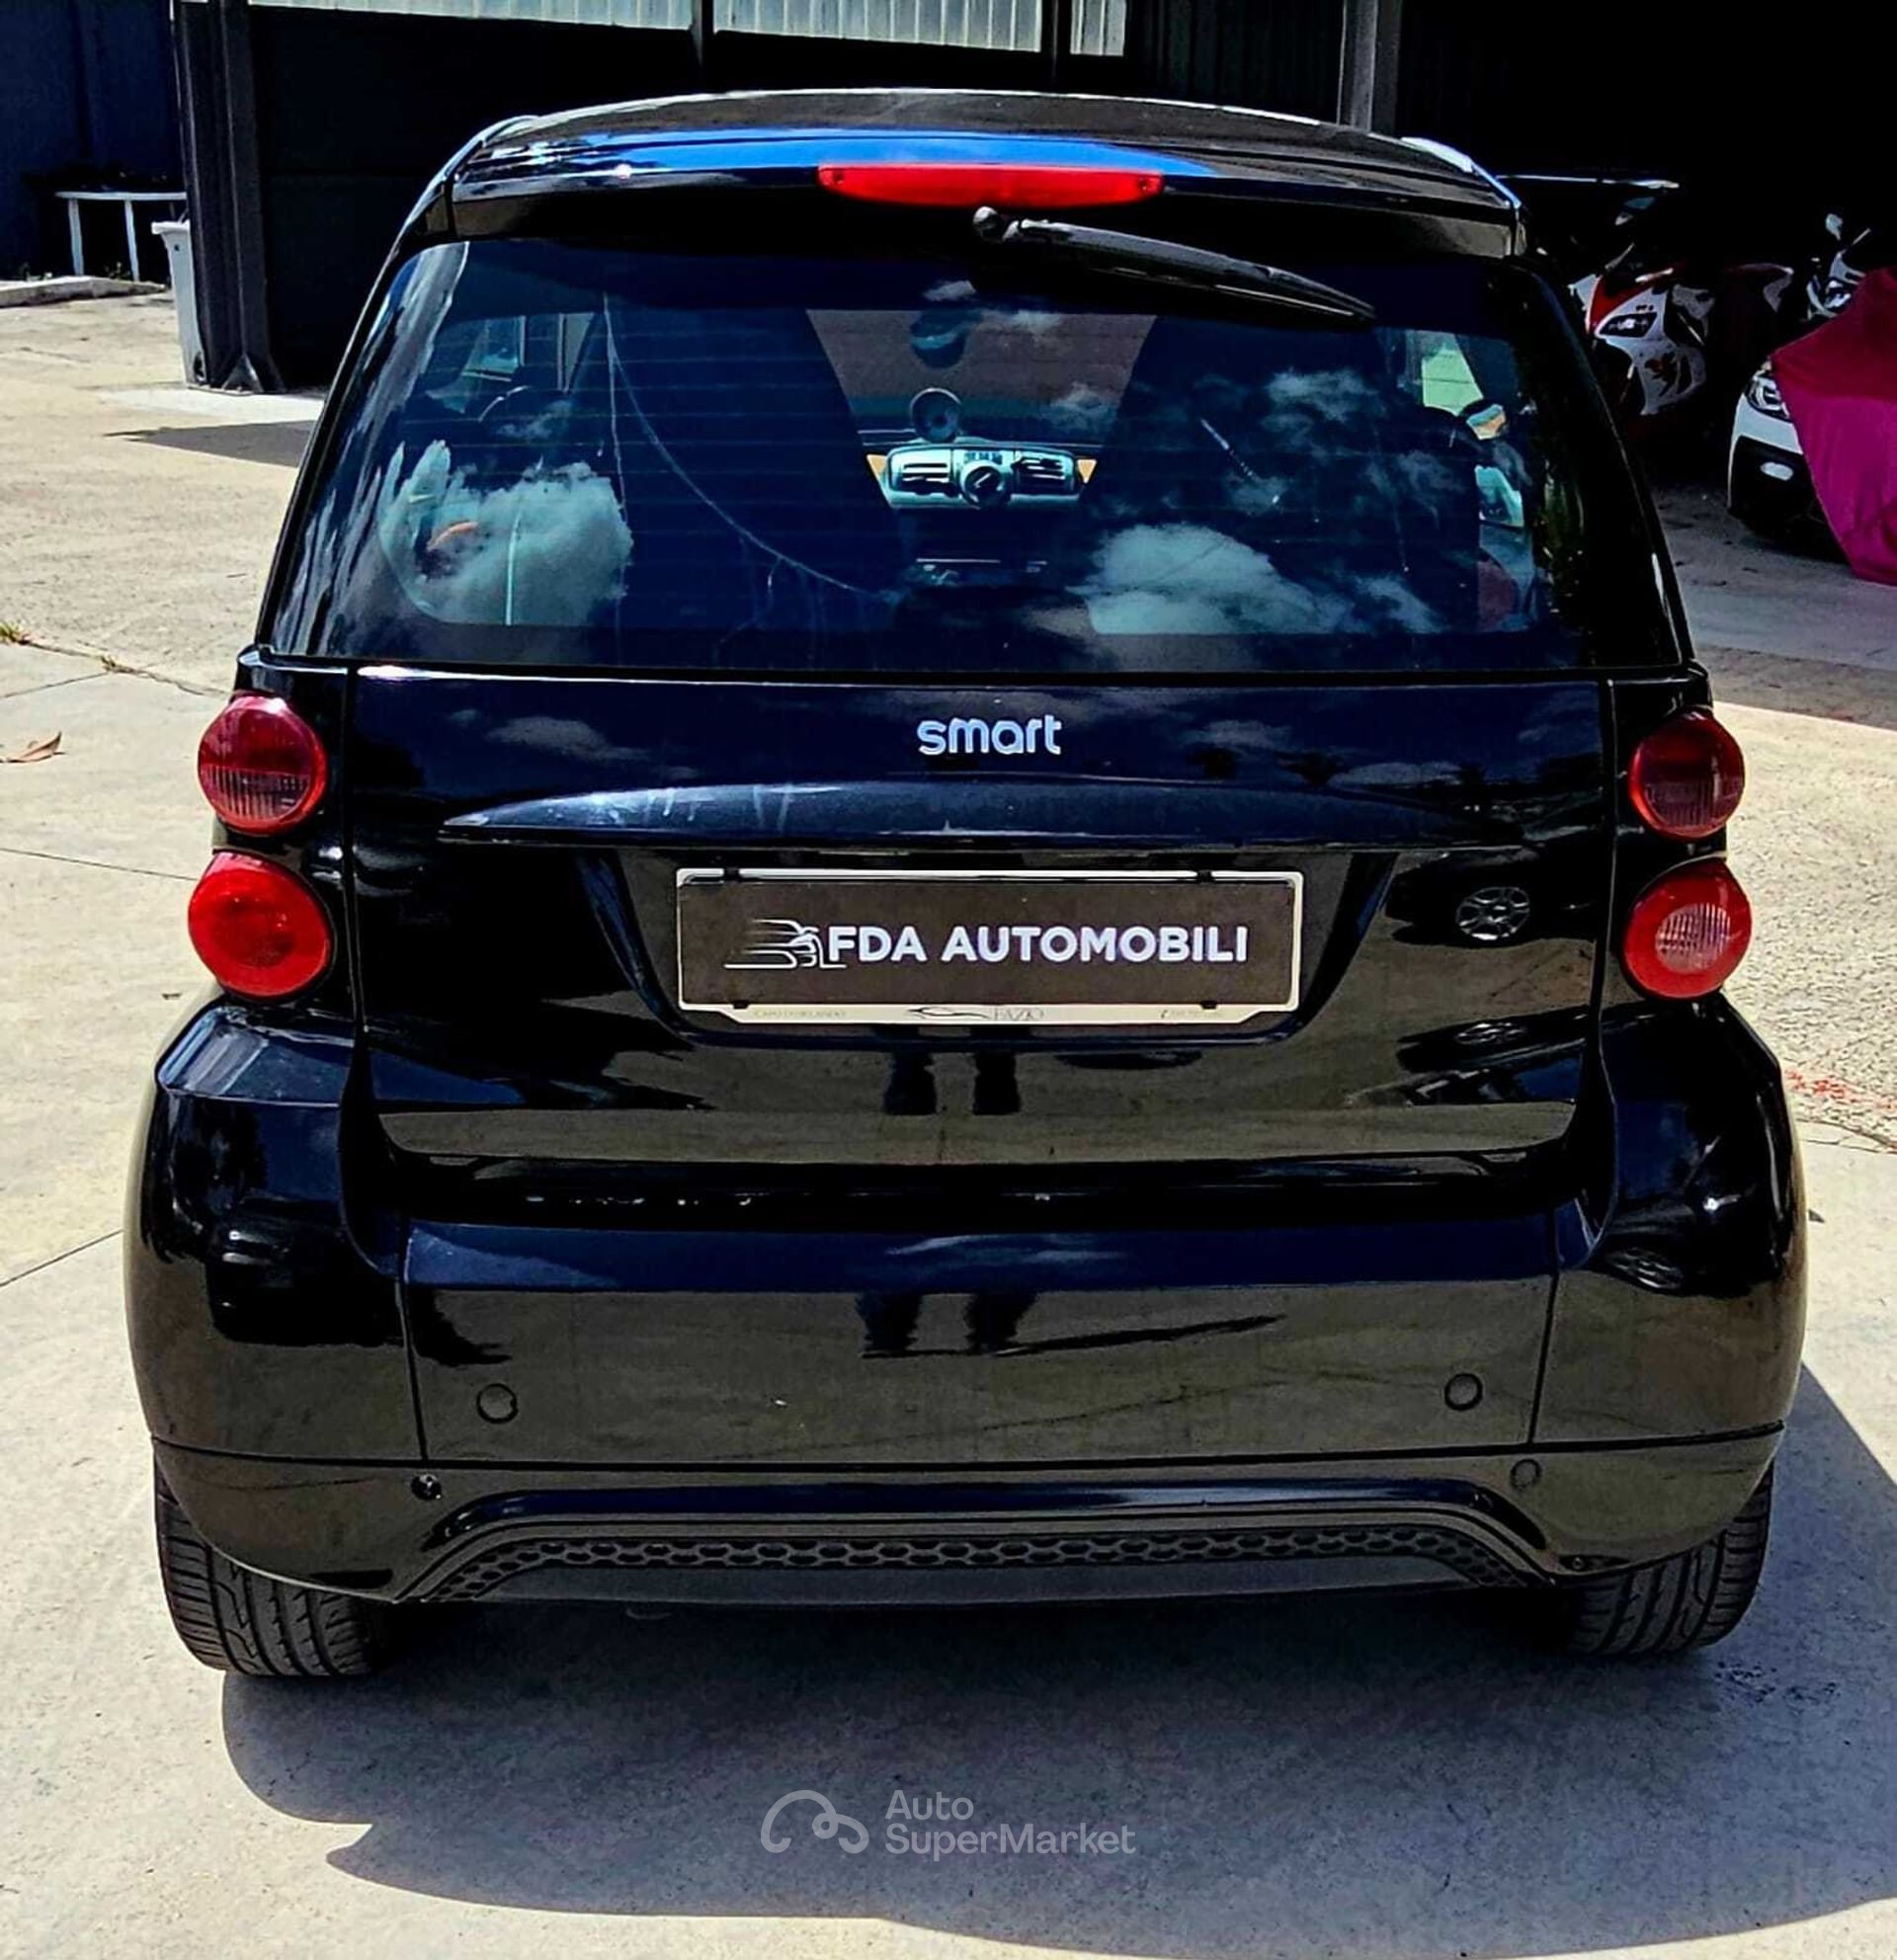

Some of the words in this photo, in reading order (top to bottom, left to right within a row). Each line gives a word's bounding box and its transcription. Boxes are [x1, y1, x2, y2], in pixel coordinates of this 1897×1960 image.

[917, 714, 1062, 755] smart
[829, 926, 928, 961] FDA
[941, 926, 1249, 962] AUTOMOBILI
